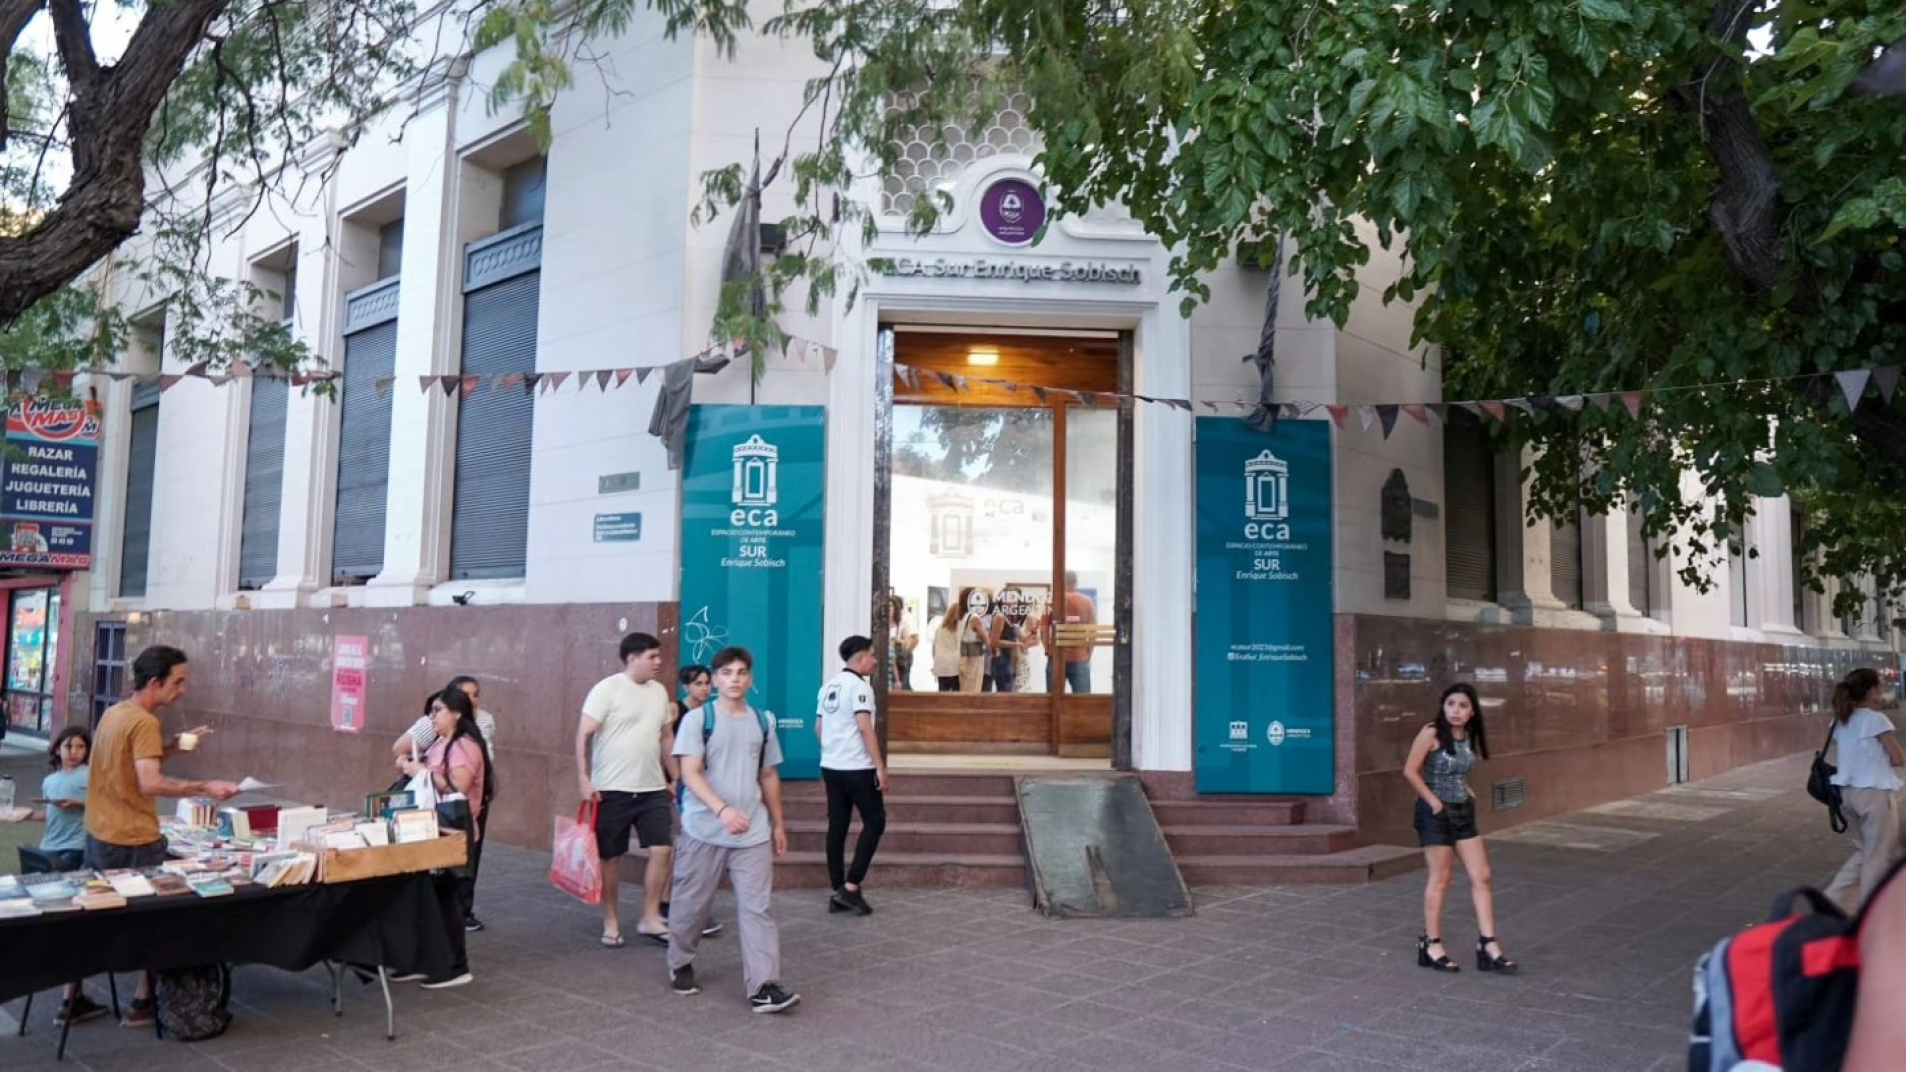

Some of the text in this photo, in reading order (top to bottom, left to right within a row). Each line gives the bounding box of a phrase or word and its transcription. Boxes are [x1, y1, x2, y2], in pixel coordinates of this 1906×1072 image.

[935, 257, 968, 278] Sur
[975, 258, 1050, 283] Enrique
[1060, 261, 1142, 285] Sobisch
[28, 446, 74, 461] BAZAR
[11, 463, 87, 479] REGALERÍA
[5, 480, 91, 497] JUGUETERÍA
[16, 498, 78, 514] LIBRERÍA
[730, 508, 778, 526] eca
[1244, 522, 1290, 540] eca
[739, 545, 767, 557] SUR
[721, 557, 786, 568] Enrique Sobisch
[1253, 558, 1280, 570] SUR
[1236, 571, 1298, 581] Enrique Sobisch
[992, 590, 1053, 603] MENDOZ
[992, 604, 1053, 615] ARGENTIN
